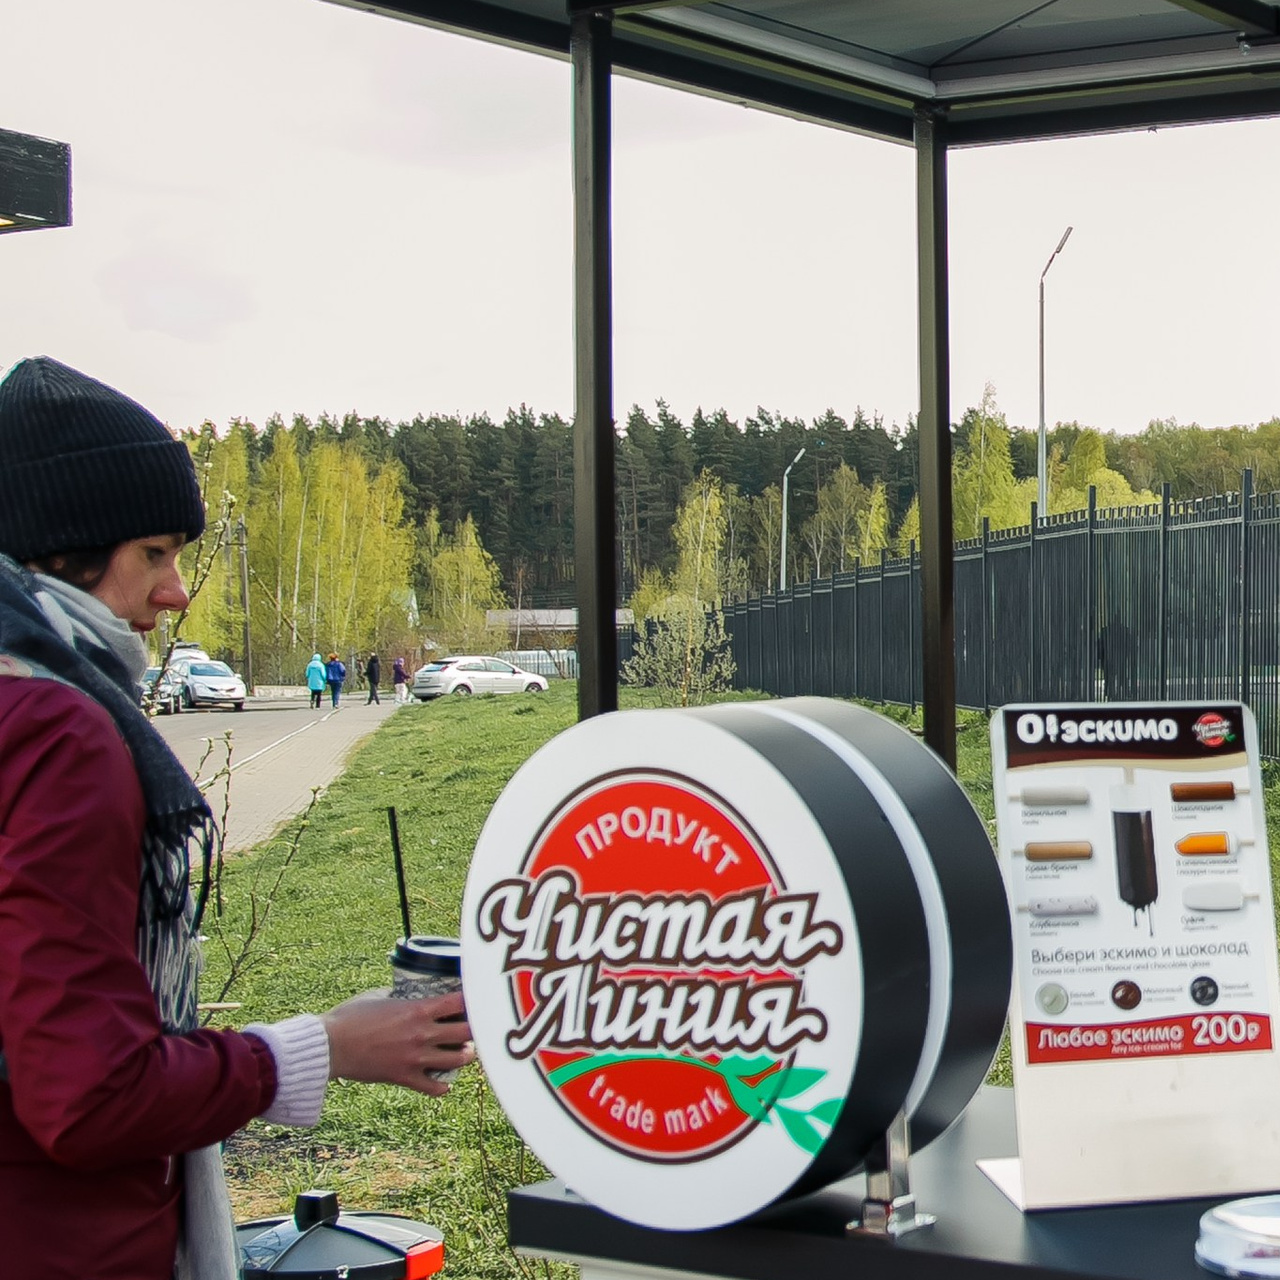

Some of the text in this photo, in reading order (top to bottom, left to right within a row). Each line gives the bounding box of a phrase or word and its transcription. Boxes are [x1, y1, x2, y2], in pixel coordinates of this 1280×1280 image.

[575, 806, 741, 876] ПРОДУКТ
[479, 870, 842, 969] Чистая
[1031, 941, 1249, 965] Выбери эскимо и шоколад
[509, 966, 827, 1058] Линия
[1038, 1026, 1108, 1049] Любое
[1111, 1025, 1184, 1045] эскимо
[587, 1074, 728, 1136] trade mark
